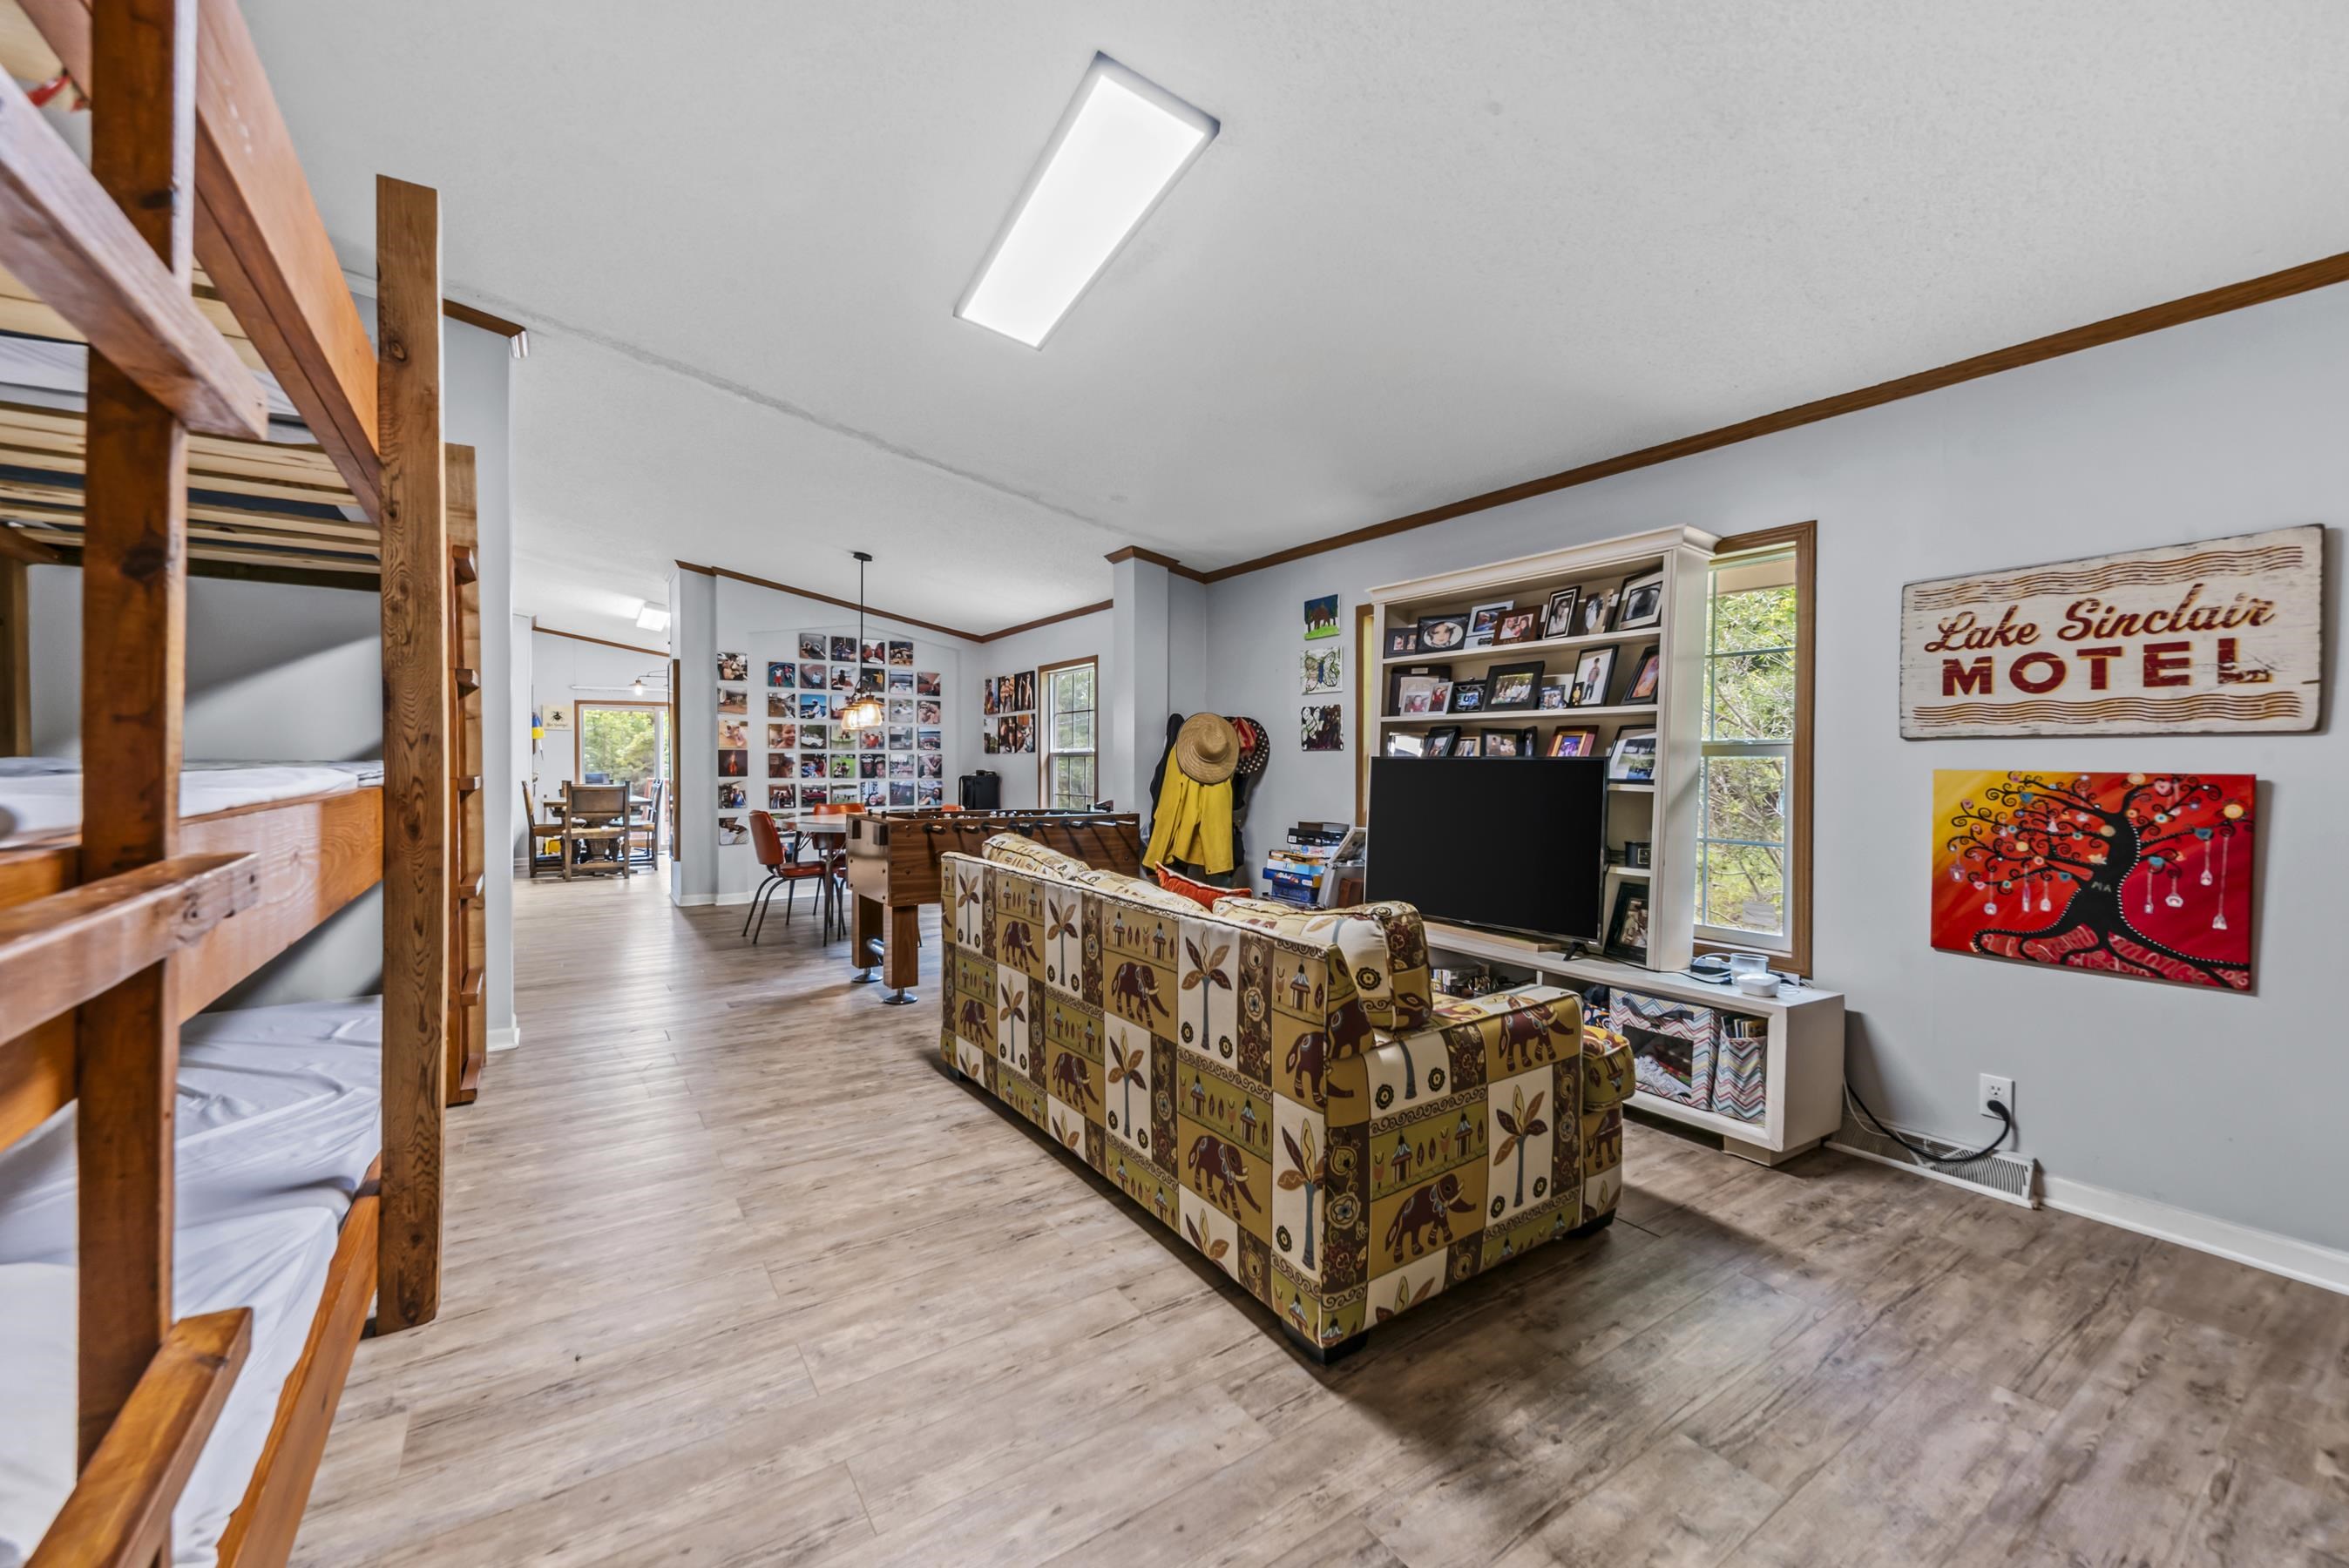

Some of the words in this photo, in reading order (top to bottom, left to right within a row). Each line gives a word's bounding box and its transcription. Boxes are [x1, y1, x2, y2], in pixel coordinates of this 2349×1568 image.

[1924, 605, 2040, 652] Lake
[2057, 583, 2277, 642] Sinclair
[1942, 637, 2273, 696] MOTEL
